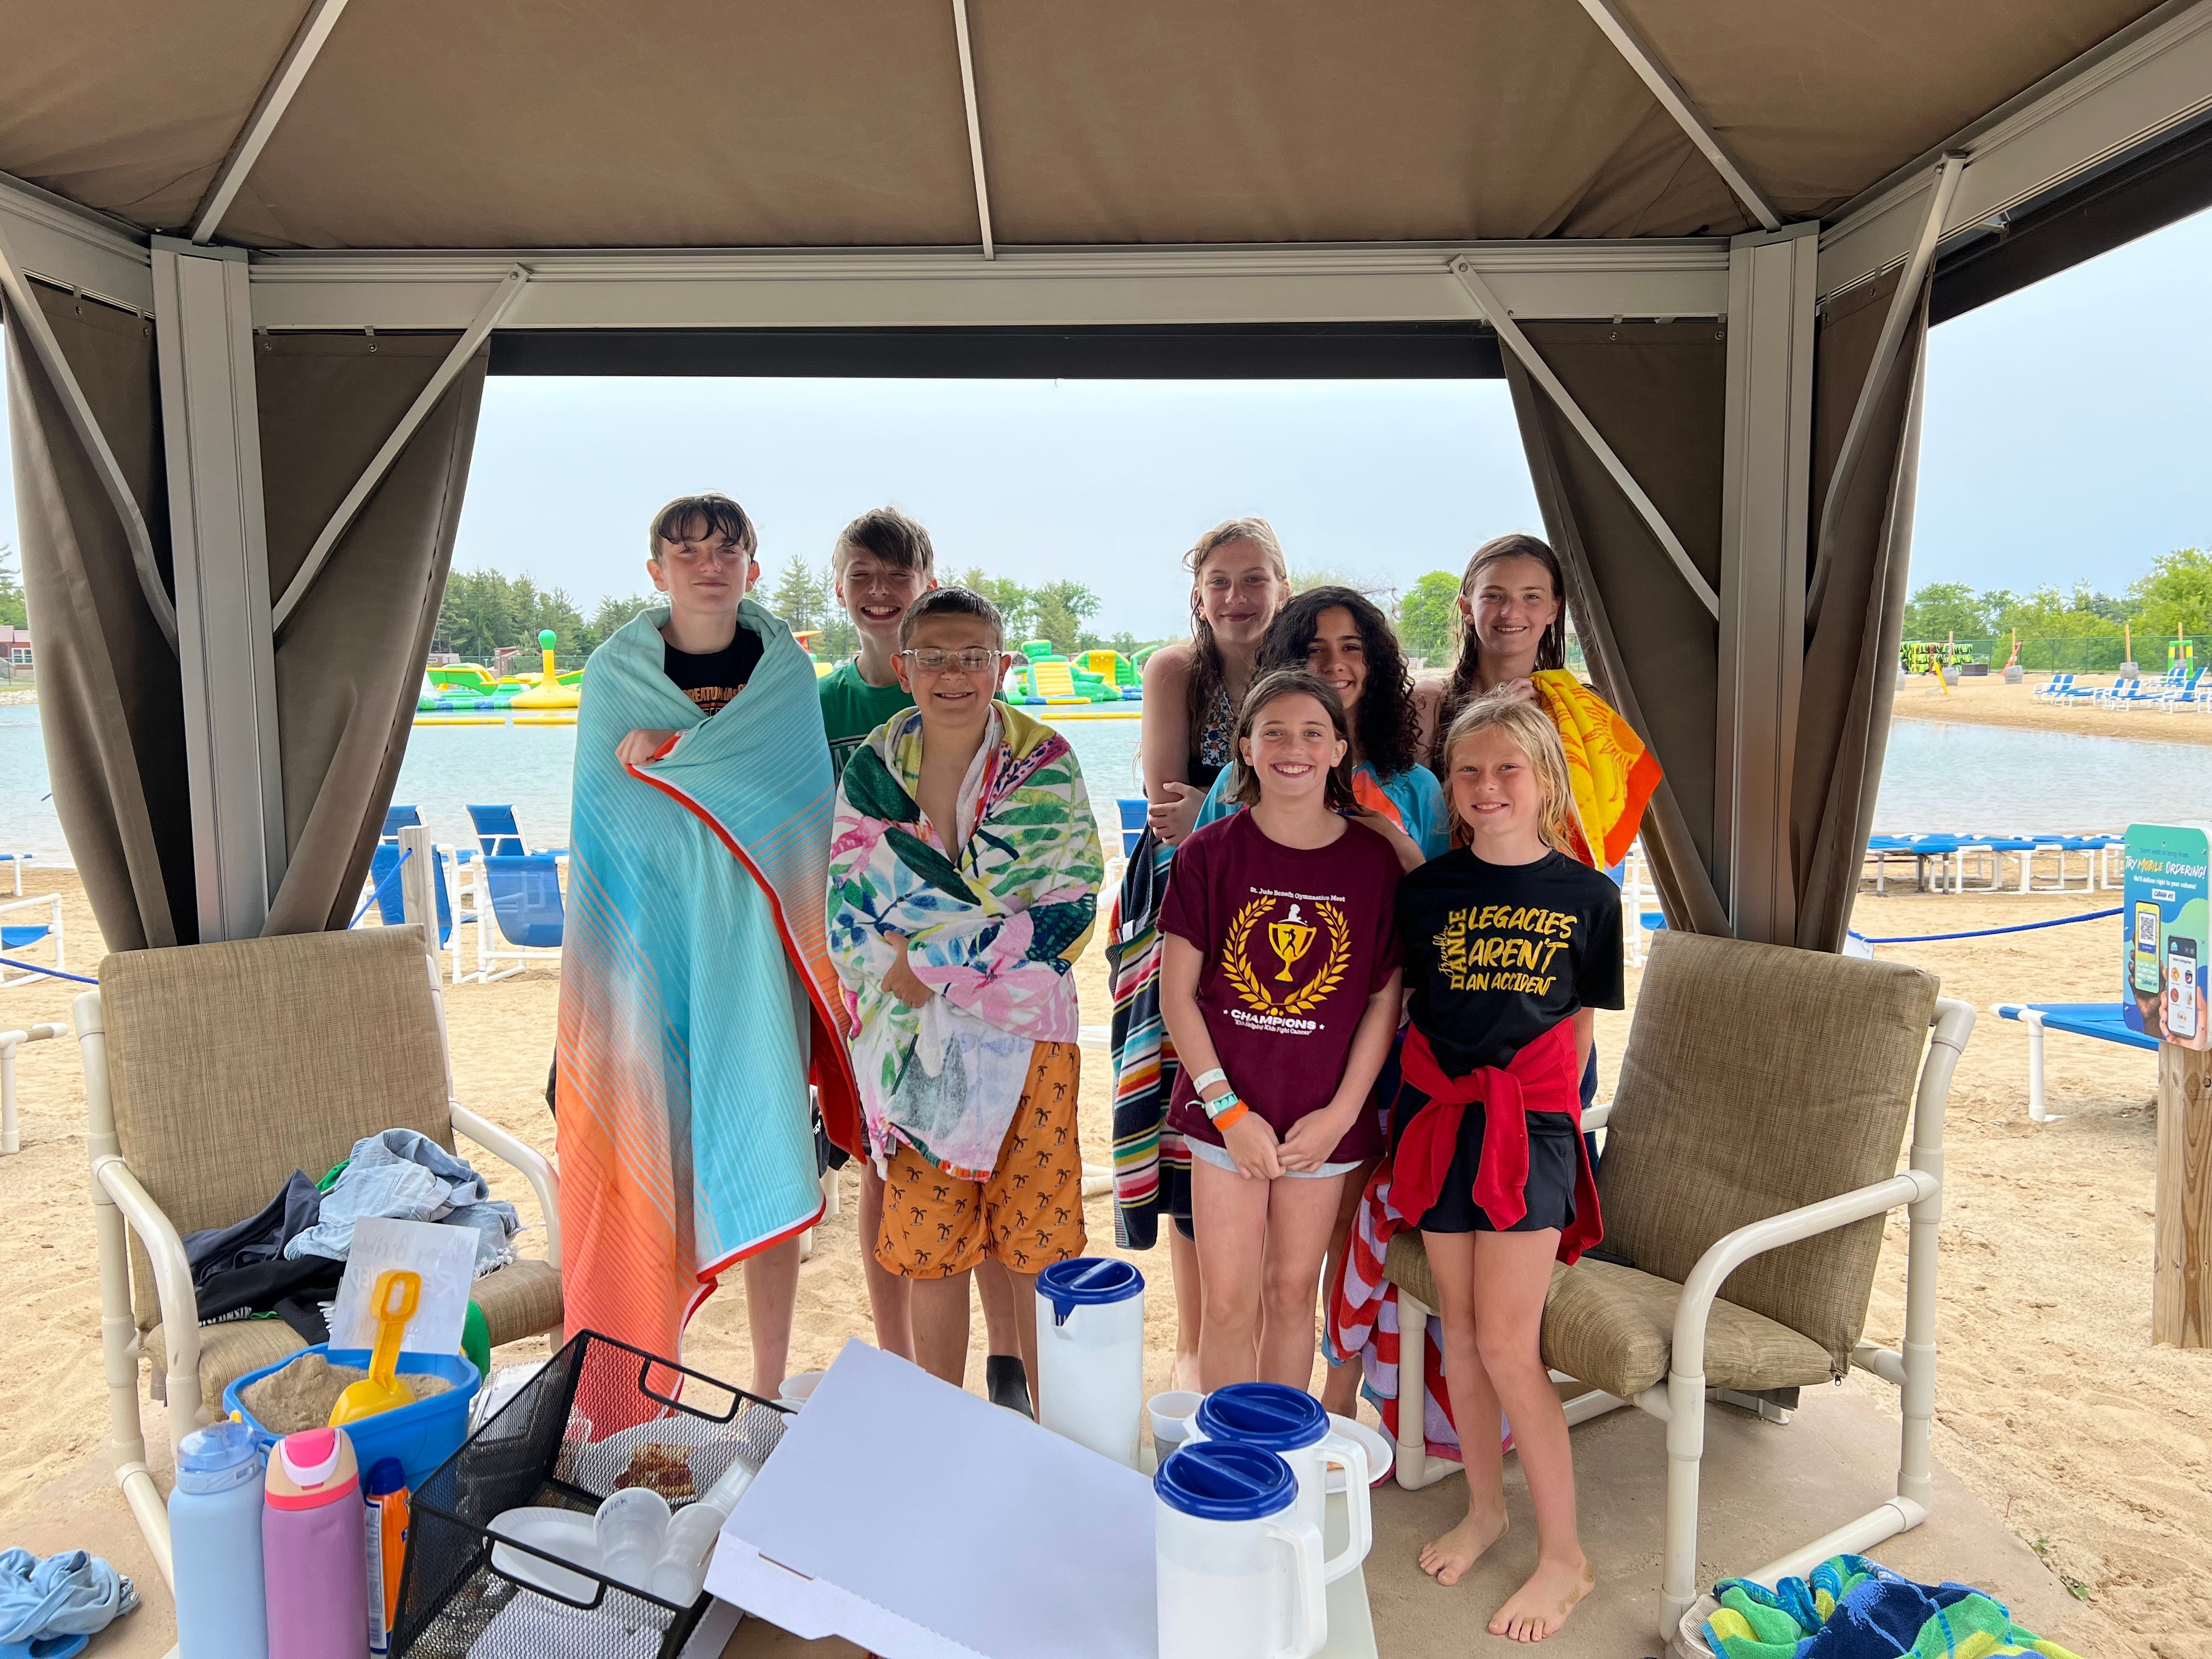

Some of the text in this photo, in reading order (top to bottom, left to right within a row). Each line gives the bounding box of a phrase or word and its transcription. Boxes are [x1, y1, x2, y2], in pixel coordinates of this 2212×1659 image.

[2125, 856, 2208, 879] TRY MOBILE ORDERING!
[2156, 878, 2166, 886] right
[1468, 905, 1578, 939] LEGACIES
[1432, 925, 1455, 978] Franklin
[1447, 907, 1468, 990] DANCE
[1468, 937, 1569, 974] AREN'T
[1466, 972, 1556, 997] AN ACCIDENT
[1231, 1009, 1317, 1030] CHAMPIONS
